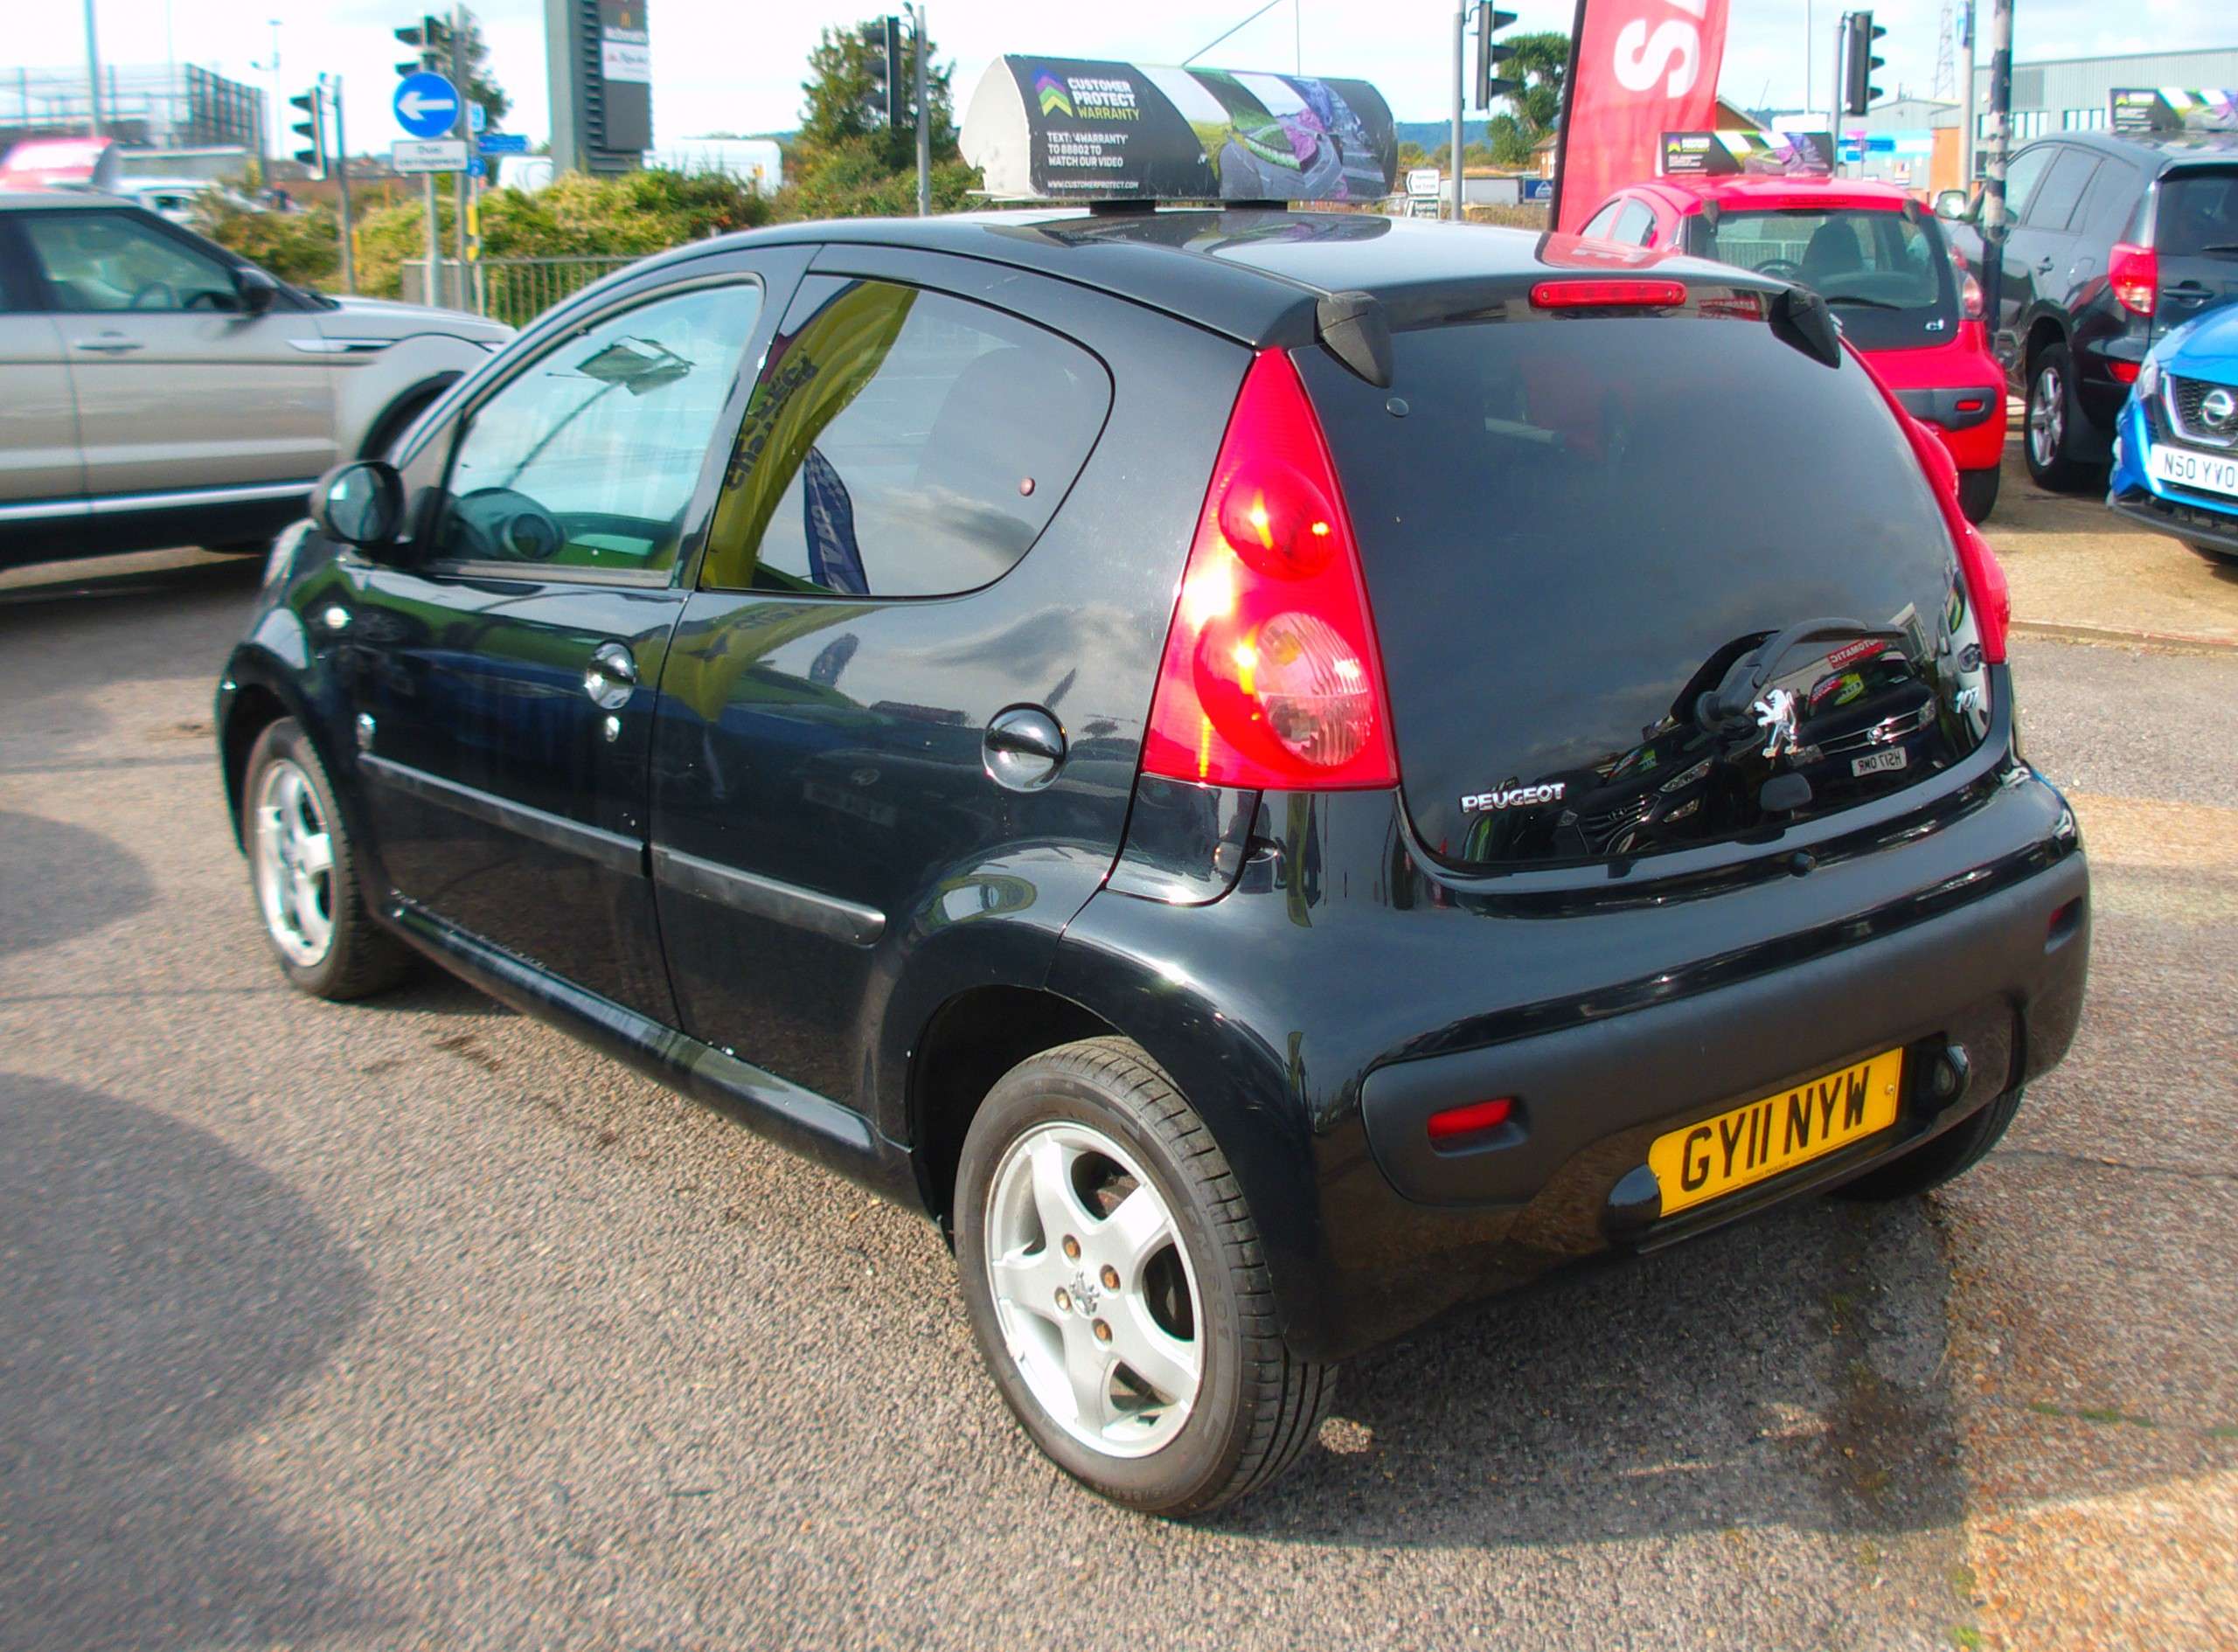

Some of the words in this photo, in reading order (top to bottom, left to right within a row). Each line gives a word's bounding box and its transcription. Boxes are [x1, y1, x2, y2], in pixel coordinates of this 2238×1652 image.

[1067, 77, 1132, 93] CUSTOMER
[1072, 91, 1136, 107] PROTECT
[1077, 107, 1140, 121] WARRANTY
[1047, 132, 1072, 143] TEXT:
[1047, 144, 1060, 155] TO
[1090, 145, 1102, 156] TO
[1048, 156, 1078, 167] WATCH
[1080, 157, 1097, 167] OUR
[1098, 157, 1123, 168] VIDEO
[1955, 686, 1980, 714] 107
[1461, 783, 1565, 813] PEUGEOT
[1681, 1103, 1773, 1192] GY11
[1783, 1065, 1870, 1156] NYW
